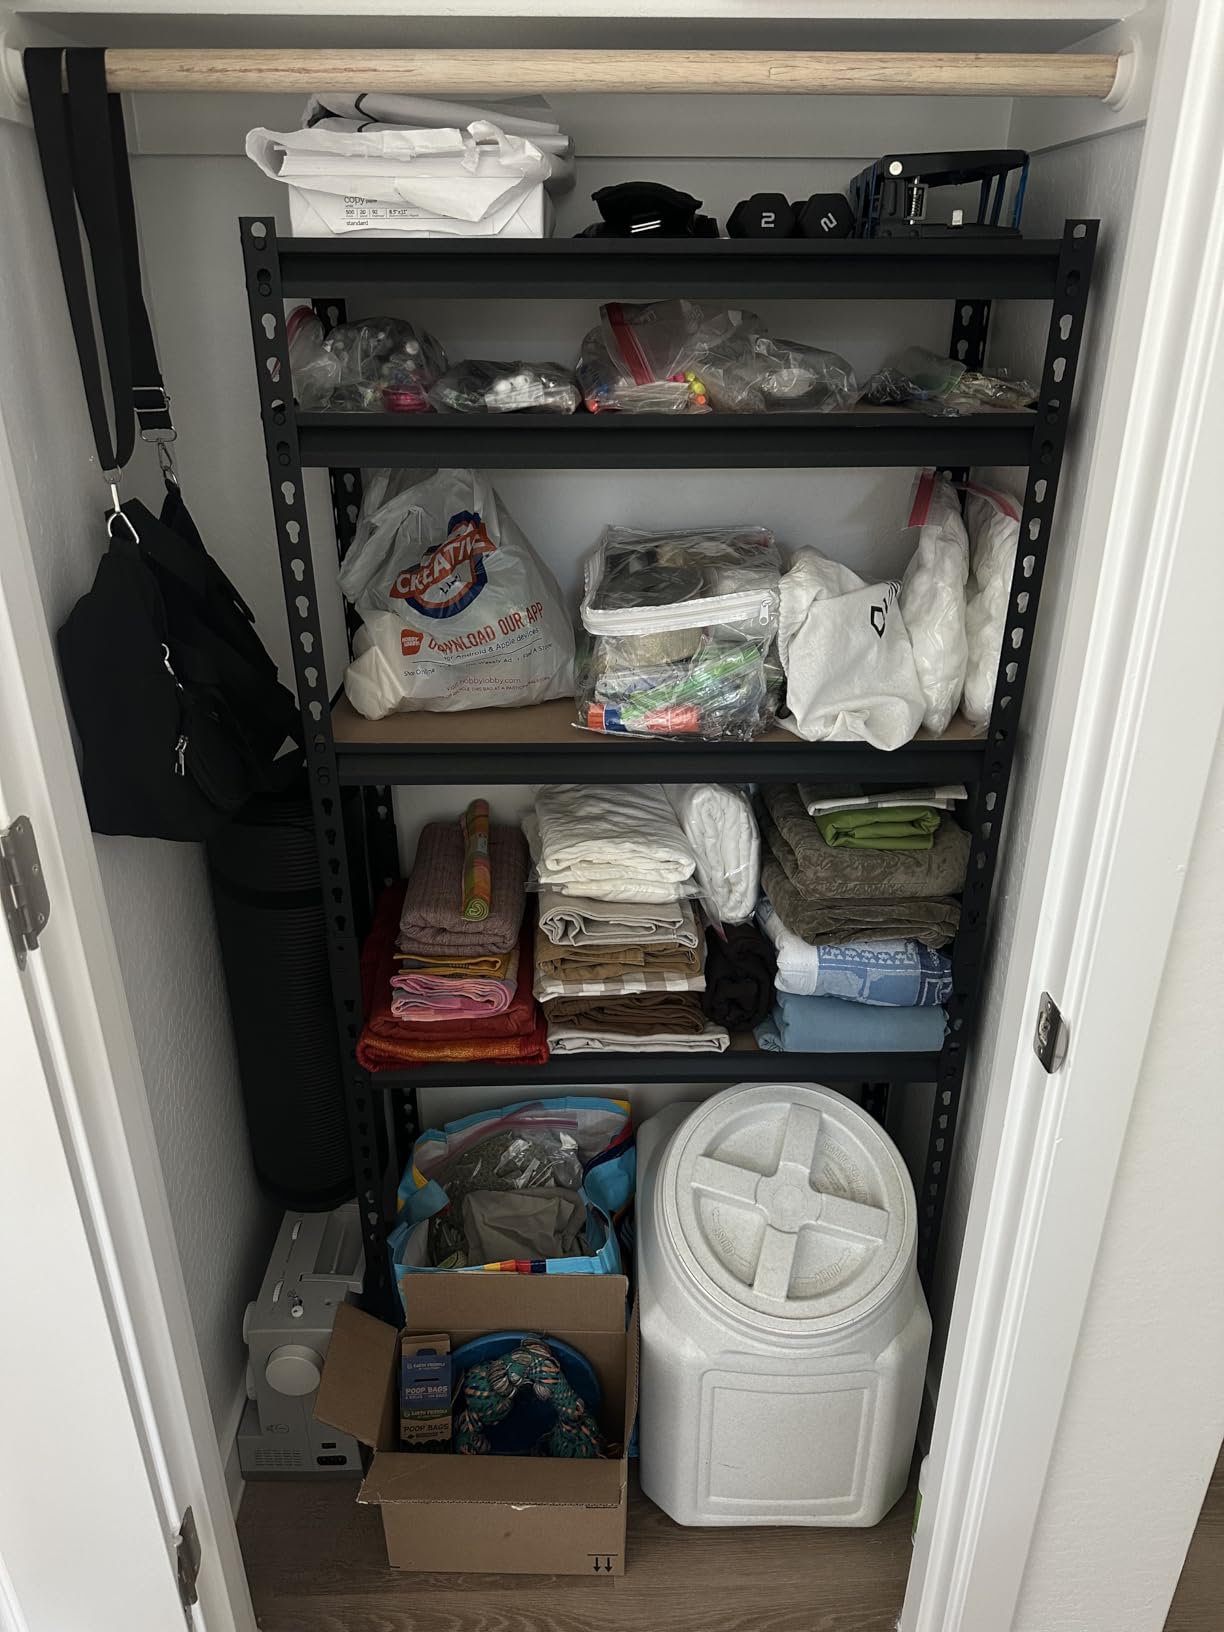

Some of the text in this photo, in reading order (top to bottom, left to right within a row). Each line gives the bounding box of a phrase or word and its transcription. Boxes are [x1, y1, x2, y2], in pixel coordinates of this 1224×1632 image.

[761, 212, 776, 228] 2
[820, 212, 838, 232] 2
[498, 612, 525, 635] OUR
[526, 602, 543, 624] APP
[496, 639, 516, 651] Apple
[517, 627, 540, 642] devices
[406, 1385, 448, 1395] POOP BAGS
[403, 1423, 449, 1433] POOP BAGS
